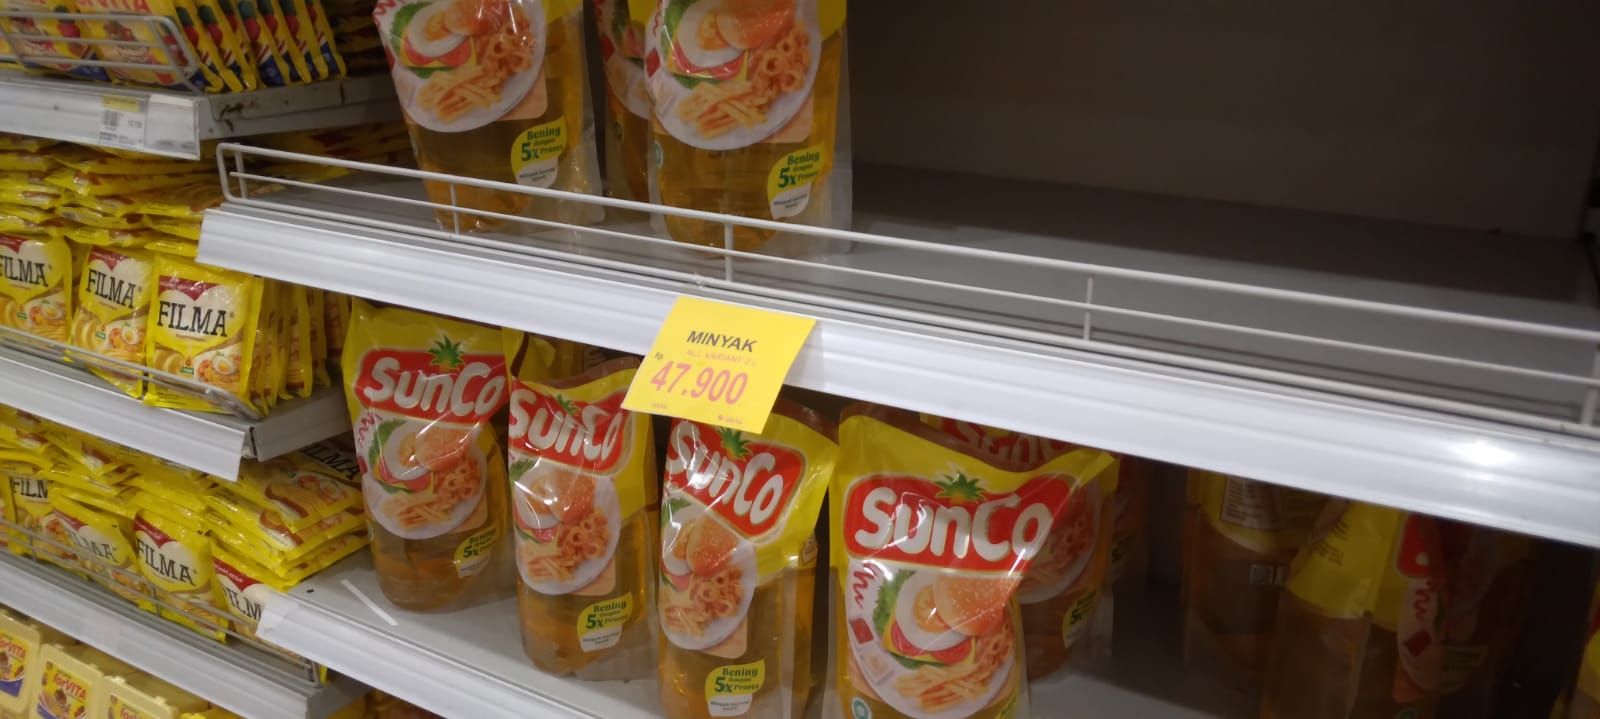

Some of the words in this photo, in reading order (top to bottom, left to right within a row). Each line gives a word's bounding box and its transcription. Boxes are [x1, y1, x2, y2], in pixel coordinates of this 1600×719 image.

[778, 167, 798, 189] 5x
[85, 268, 136, 309] FILMA
[157, 301, 228, 337] FILMA
[686, 330, 758, 352] MINYAK
[364, 356, 506, 416] SunCo
[651, 360, 748, 405] 47.900
[665, 419, 784, 525] SunCo
[854, 486, 1054, 562] SunCo
[136, 538, 196, 587] FILMA
[586, 613, 604, 629] 5x
[714, 676, 733, 693] 5x
[722, 667, 758, 678] Bening
